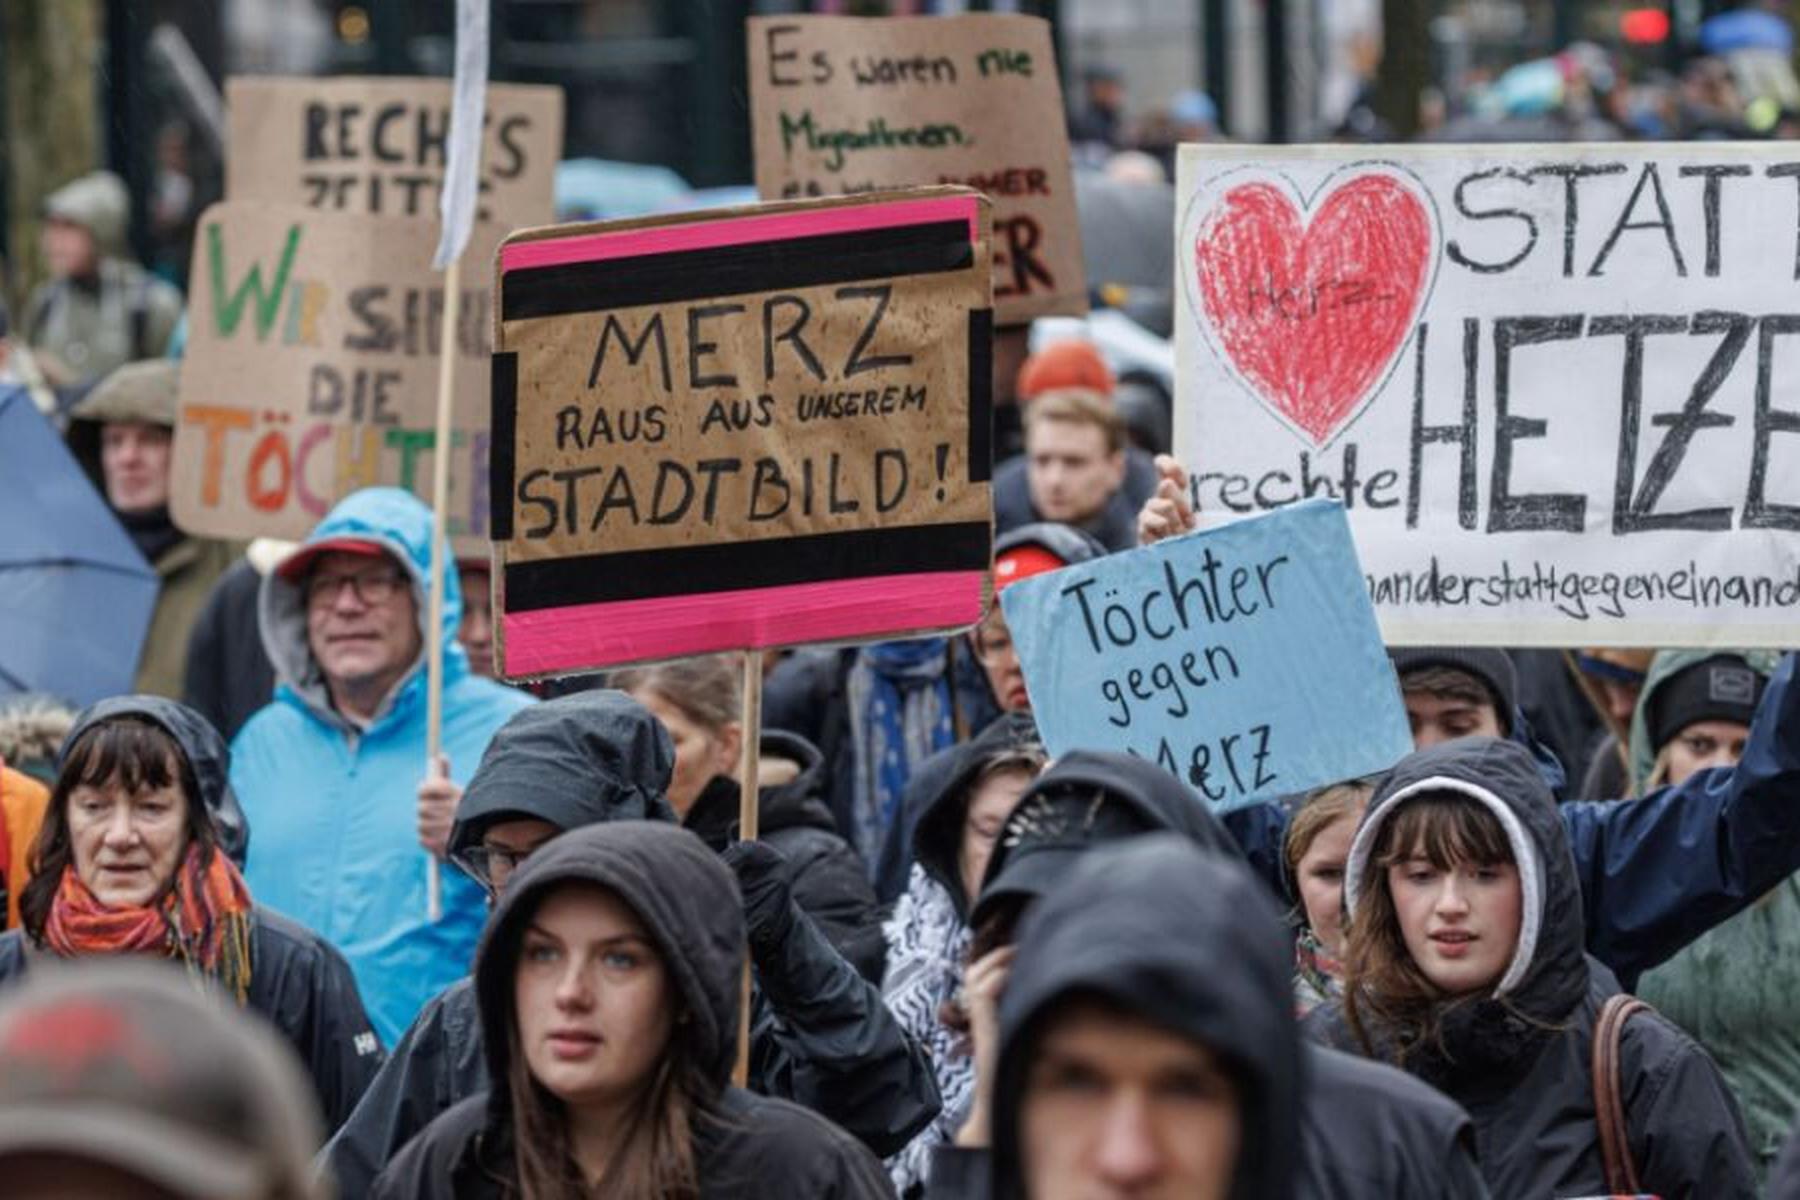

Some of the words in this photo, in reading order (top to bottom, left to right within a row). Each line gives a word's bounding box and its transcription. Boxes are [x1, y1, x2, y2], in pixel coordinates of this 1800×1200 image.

[767, 25, 834, 86] Es
[855, 55, 957, 86] waren
[976, 47, 1036, 79] nie
[303, 101, 531, 179] RECHS
[937, 167, 1051, 197] MER
[206, 222, 329, 347] WIR
[587, 284, 914, 392] MERZ
[306, 362, 403, 425] DIE
[555, 405, 668, 451] RAUS
[701, 394, 776, 435] AUS
[799, 384, 928, 423] UNSEREM
[1189, 443, 1401, 513] rechte
[1405, 310, 1800, 536] HETZE
[1061, 548, 1289, 654] Töchter
[1101, 644, 1240, 728] gegen
